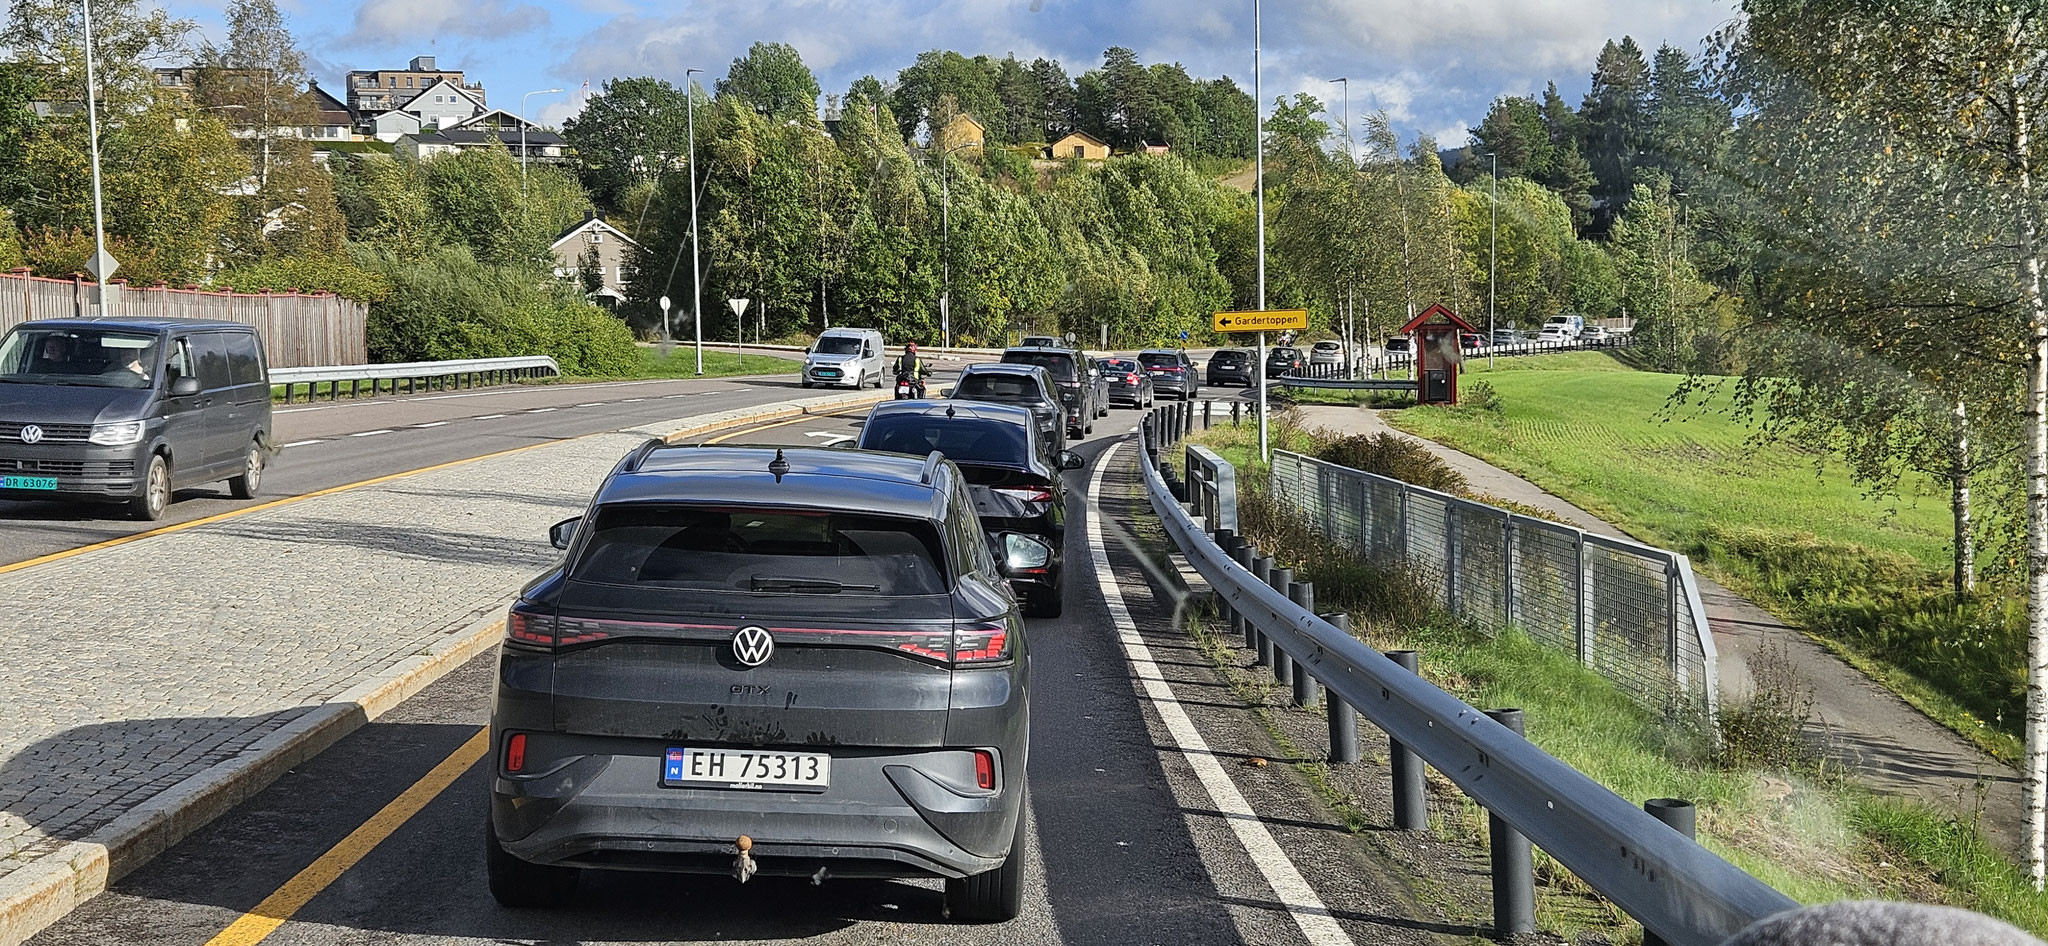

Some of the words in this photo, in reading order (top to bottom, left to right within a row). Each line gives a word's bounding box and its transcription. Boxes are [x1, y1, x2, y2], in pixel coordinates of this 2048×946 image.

[1235, 316, 1298, 326] Gardertoppen
[5, 477, 19, 487] DR
[23, 479, 54, 488] 63076
[733, 626, 772, 666] VW
[730, 685, 771, 695] GTX
[671, 767, 679, 775] N
[691, 751, 725, 777] EH
[740, 753, 819, 781] 75313
